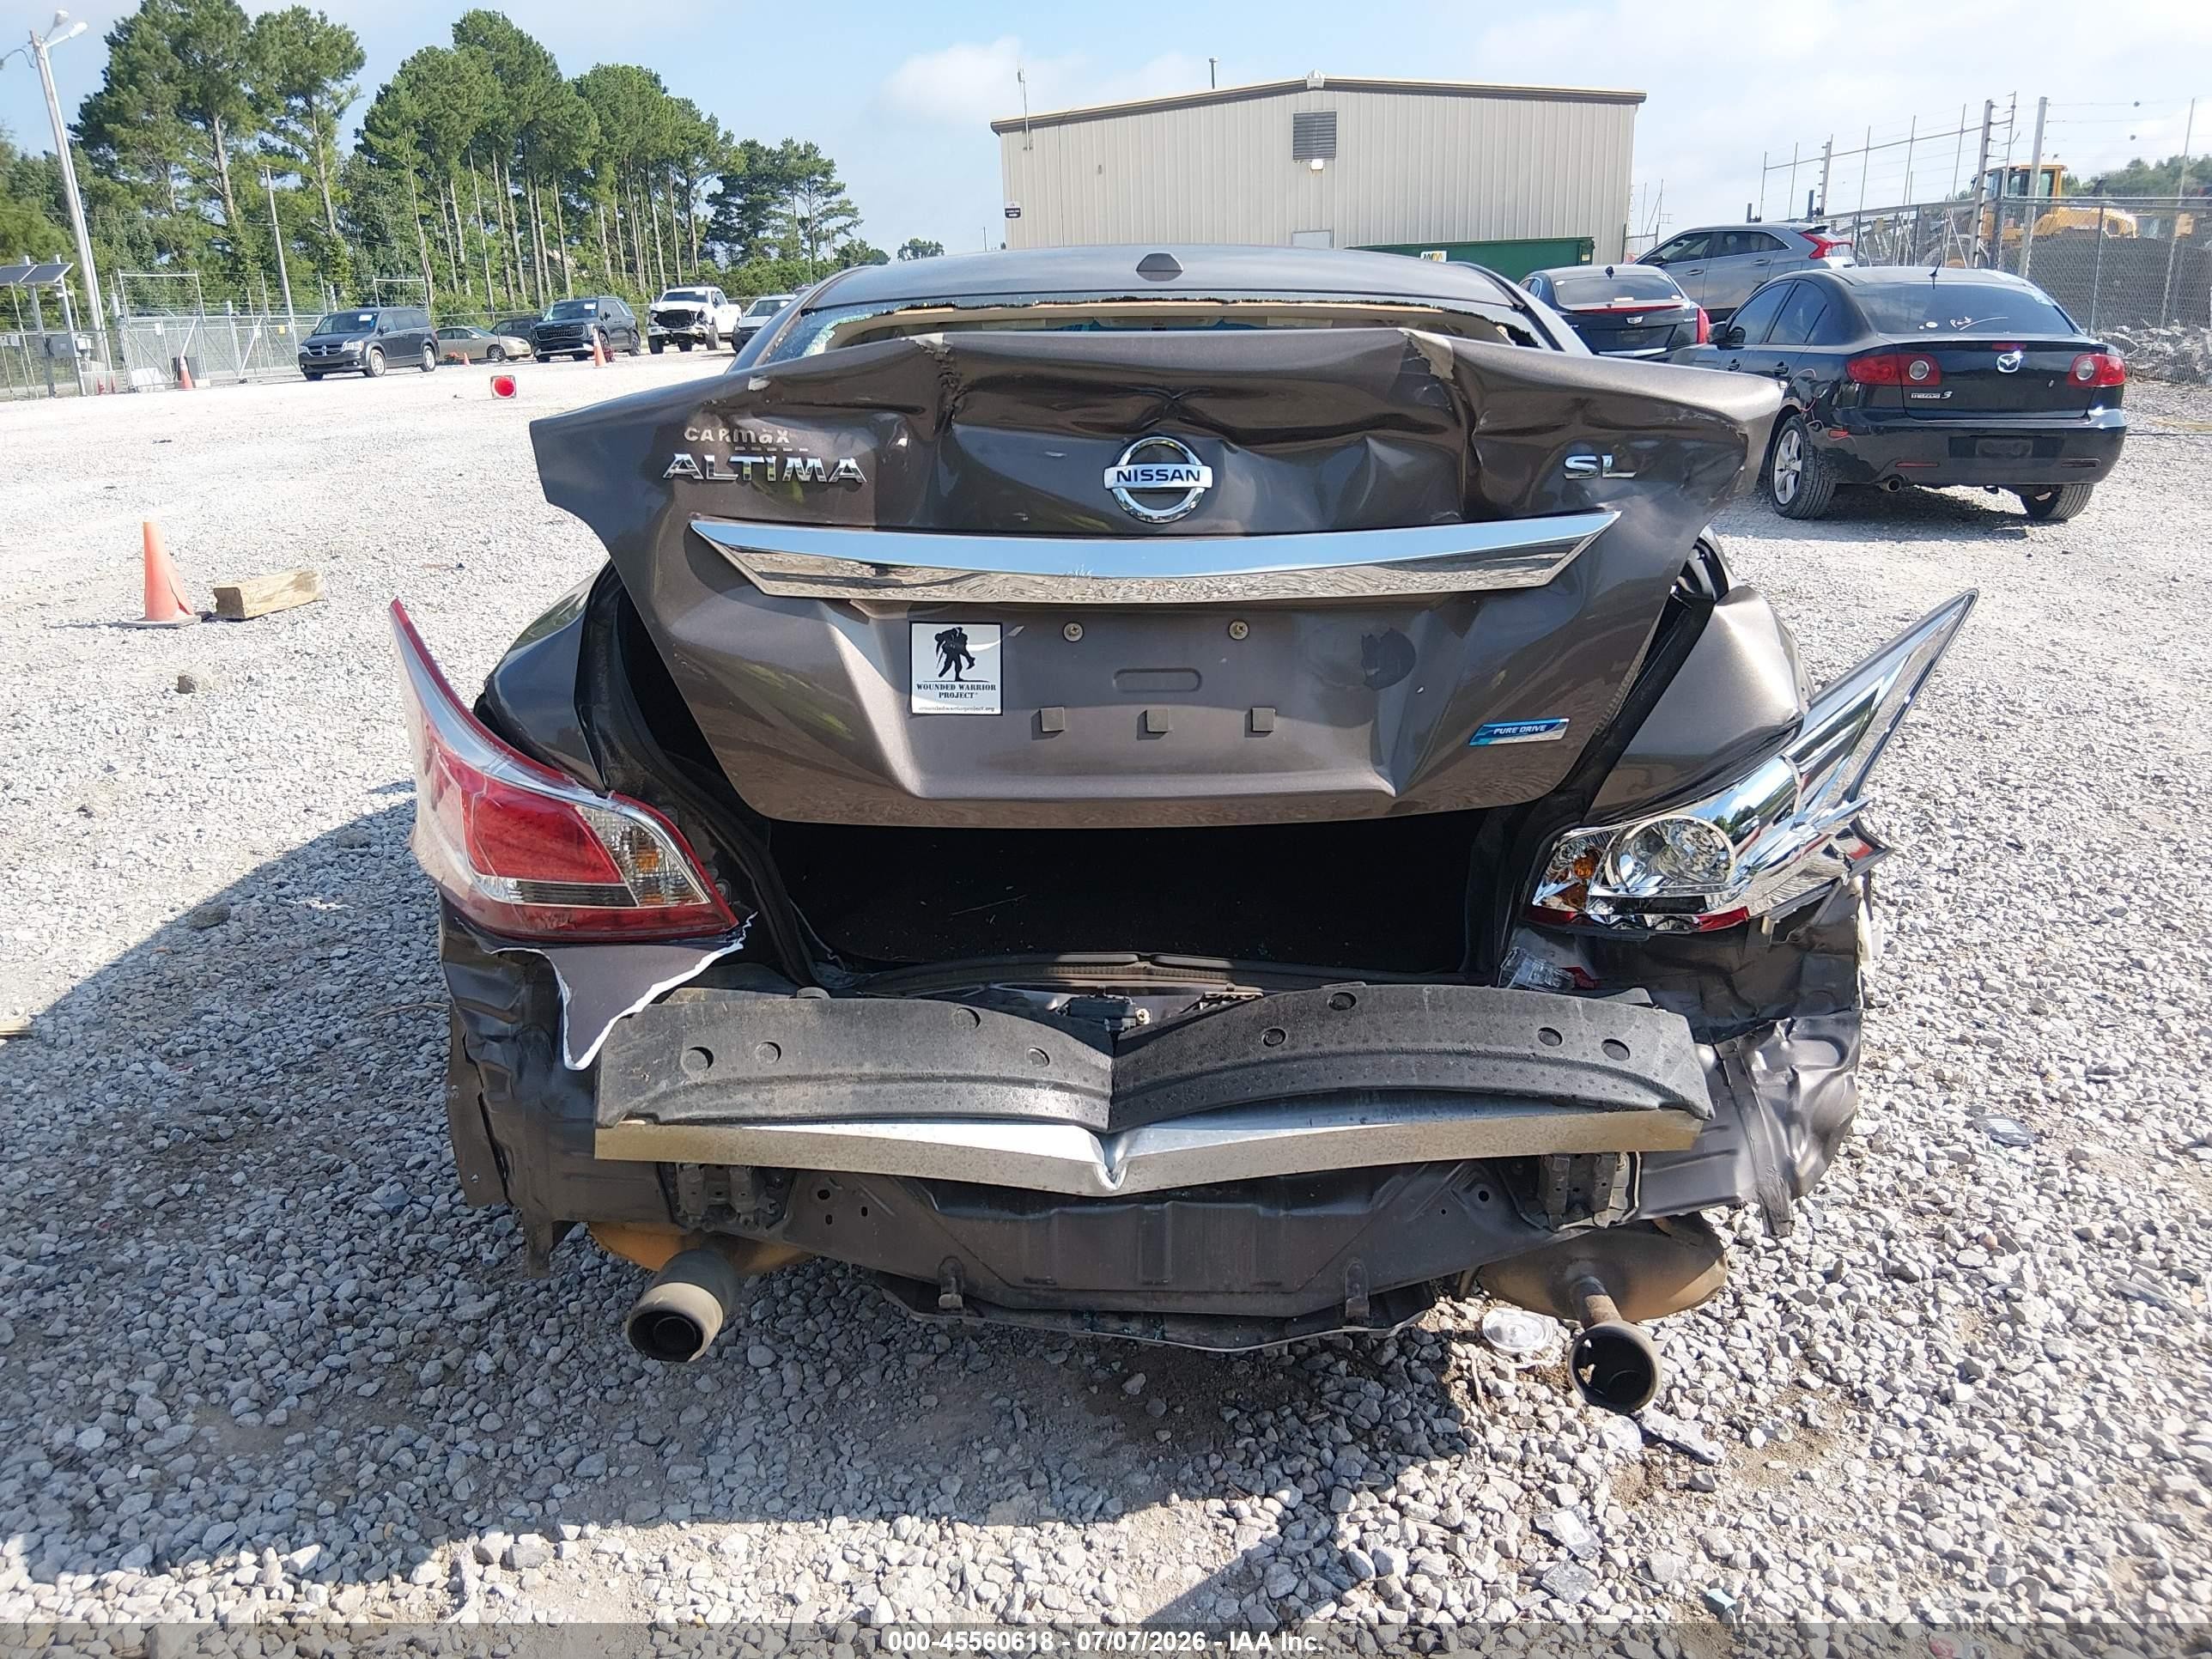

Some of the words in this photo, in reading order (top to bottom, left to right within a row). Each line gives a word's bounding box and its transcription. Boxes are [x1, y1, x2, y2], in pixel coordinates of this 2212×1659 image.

[662, 453, 867, 483] ALTIMA
[1117, 469, 1200, 482] NISSAN
[1564, 455, 1637, 478] SL
